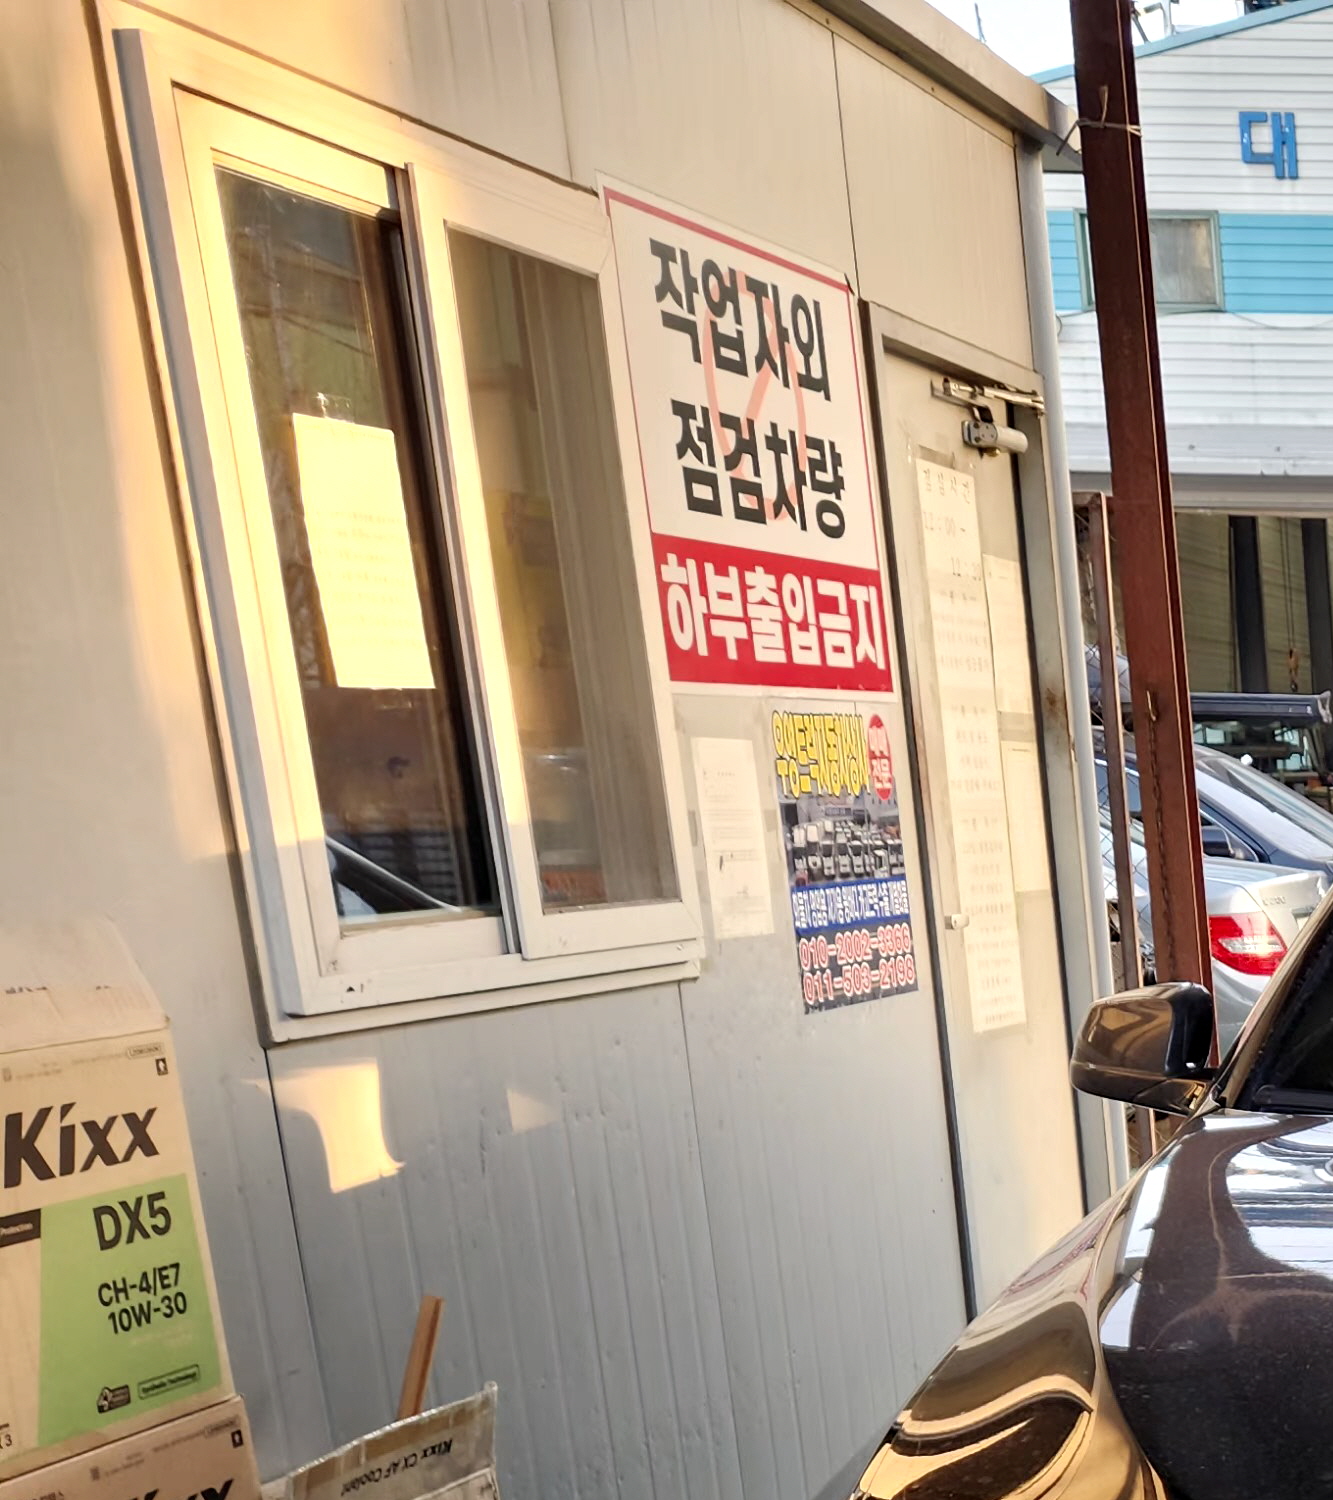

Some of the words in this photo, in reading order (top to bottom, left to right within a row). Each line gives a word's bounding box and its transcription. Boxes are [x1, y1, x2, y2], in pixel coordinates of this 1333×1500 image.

[649, 237, 831, 401] 작업자외
[670, 398, 846, 539] 점검차량
[660, 552, 887, 670] 하부출입금지
[799, 922, 912, 972] 010-2002-3366
[803, 954, 915, 1006] 011-503-2198
[4, 1102, 160, 1188] Kixx
[93, 1191, 171, 1251] DX5
[97, 1262, 181, 1307] CH-4/E7
[107, 1292, 188, 1334] 10W-30
